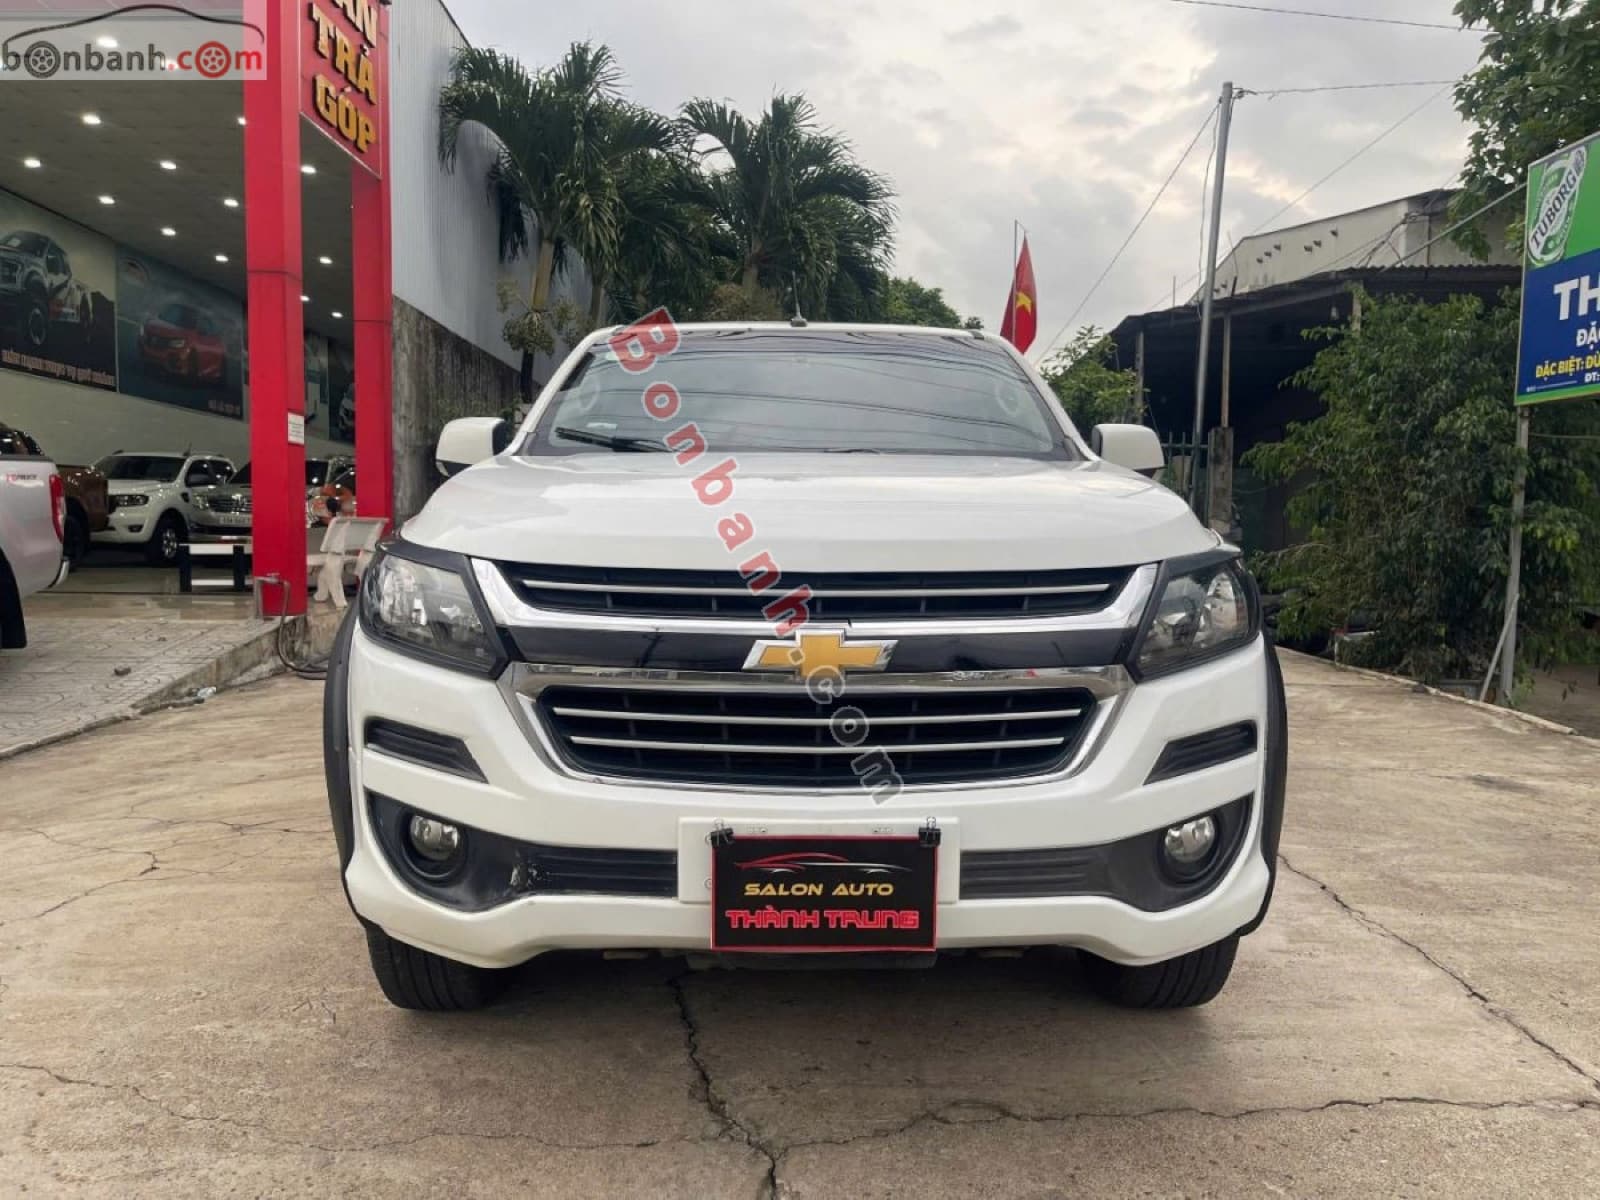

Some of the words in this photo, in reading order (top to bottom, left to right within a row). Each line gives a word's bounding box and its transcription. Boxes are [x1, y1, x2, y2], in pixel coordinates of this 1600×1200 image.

[312, 3, 377, 105] TRẢ
[315, 74, 377, 153] GÓP
[1531, 169, 1577, 249] TUBORG
[1576, 321, 1600, 350] ĐẶ
[725, 904, 820, 929] THÀNH
[823, 910, 920, 929] TRUNG
[744, 883, 823, 896] SALON
[832, 883, 894, 896] AUTO
